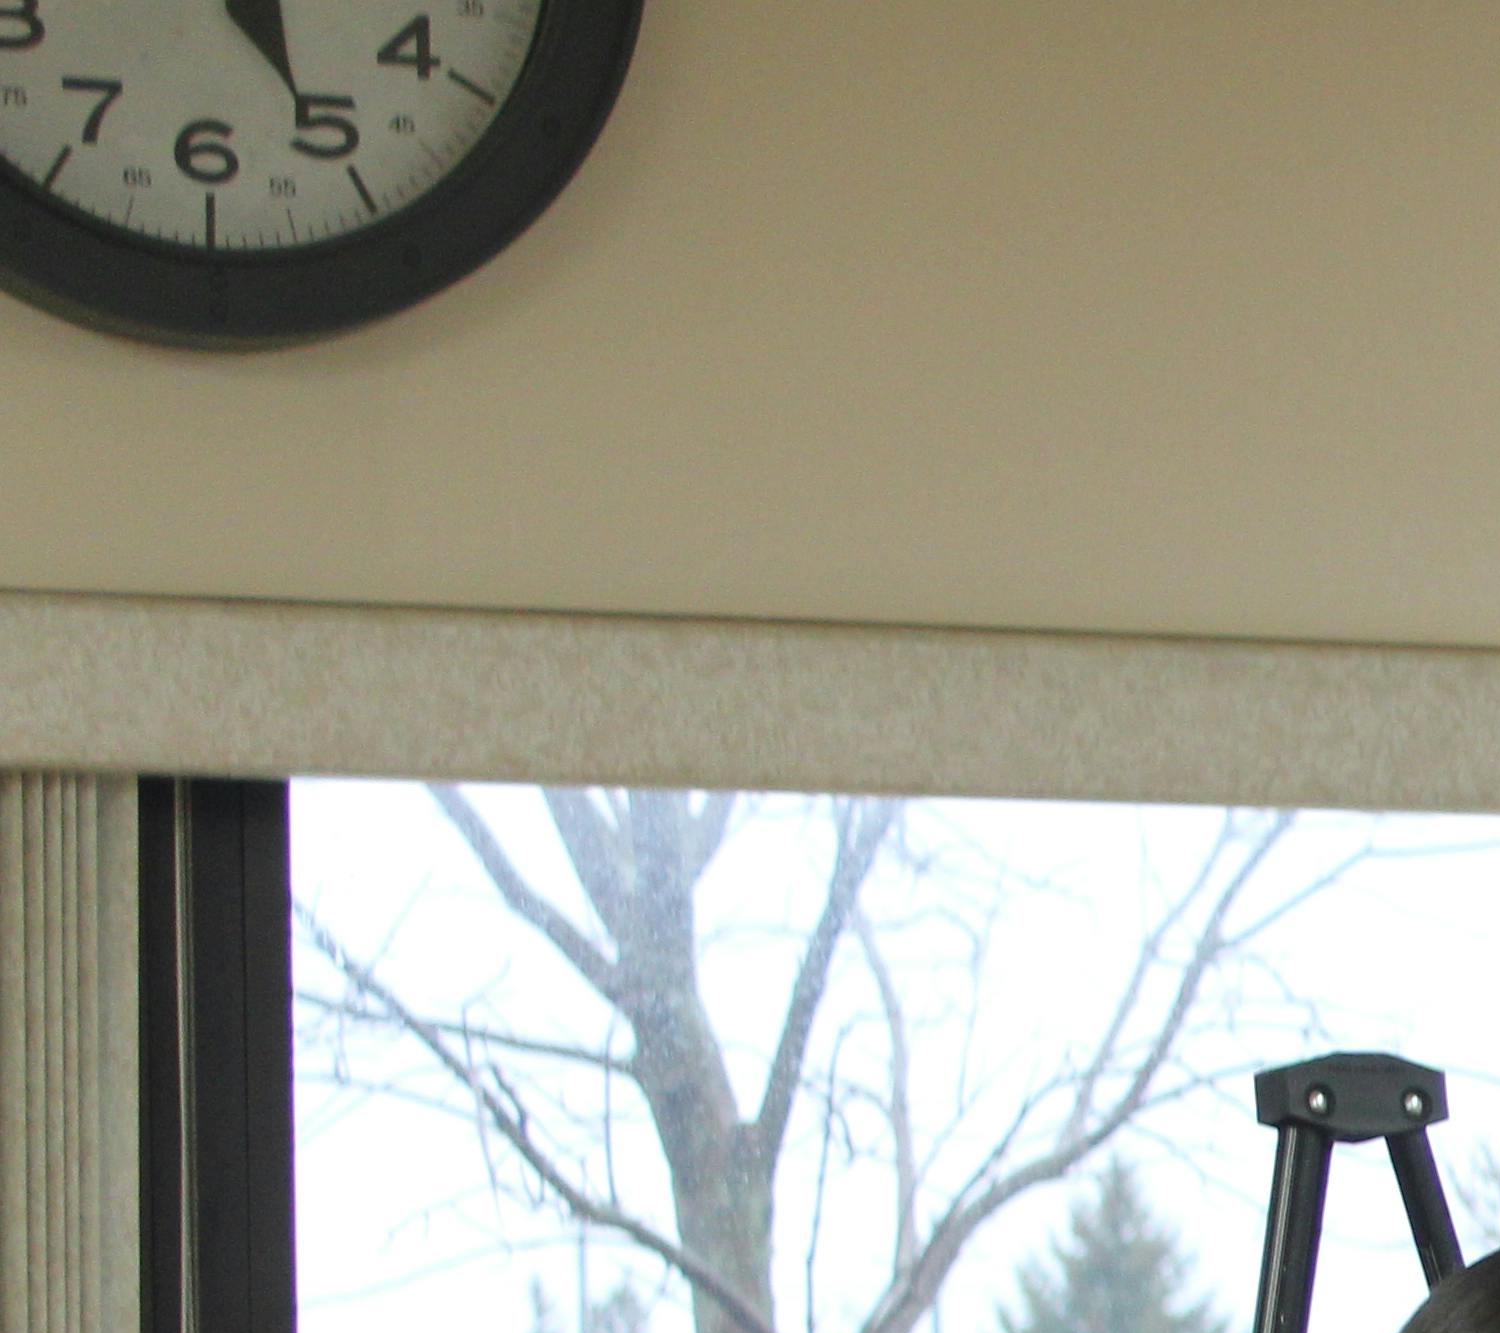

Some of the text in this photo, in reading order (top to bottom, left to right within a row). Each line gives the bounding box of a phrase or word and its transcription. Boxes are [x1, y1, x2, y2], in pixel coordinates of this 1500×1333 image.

[377, 13, 441, 80] 4
[62, 77, 122, 143] 7
[290, 93, 359, 159] 5
[174, 118, 239, 183] 6
